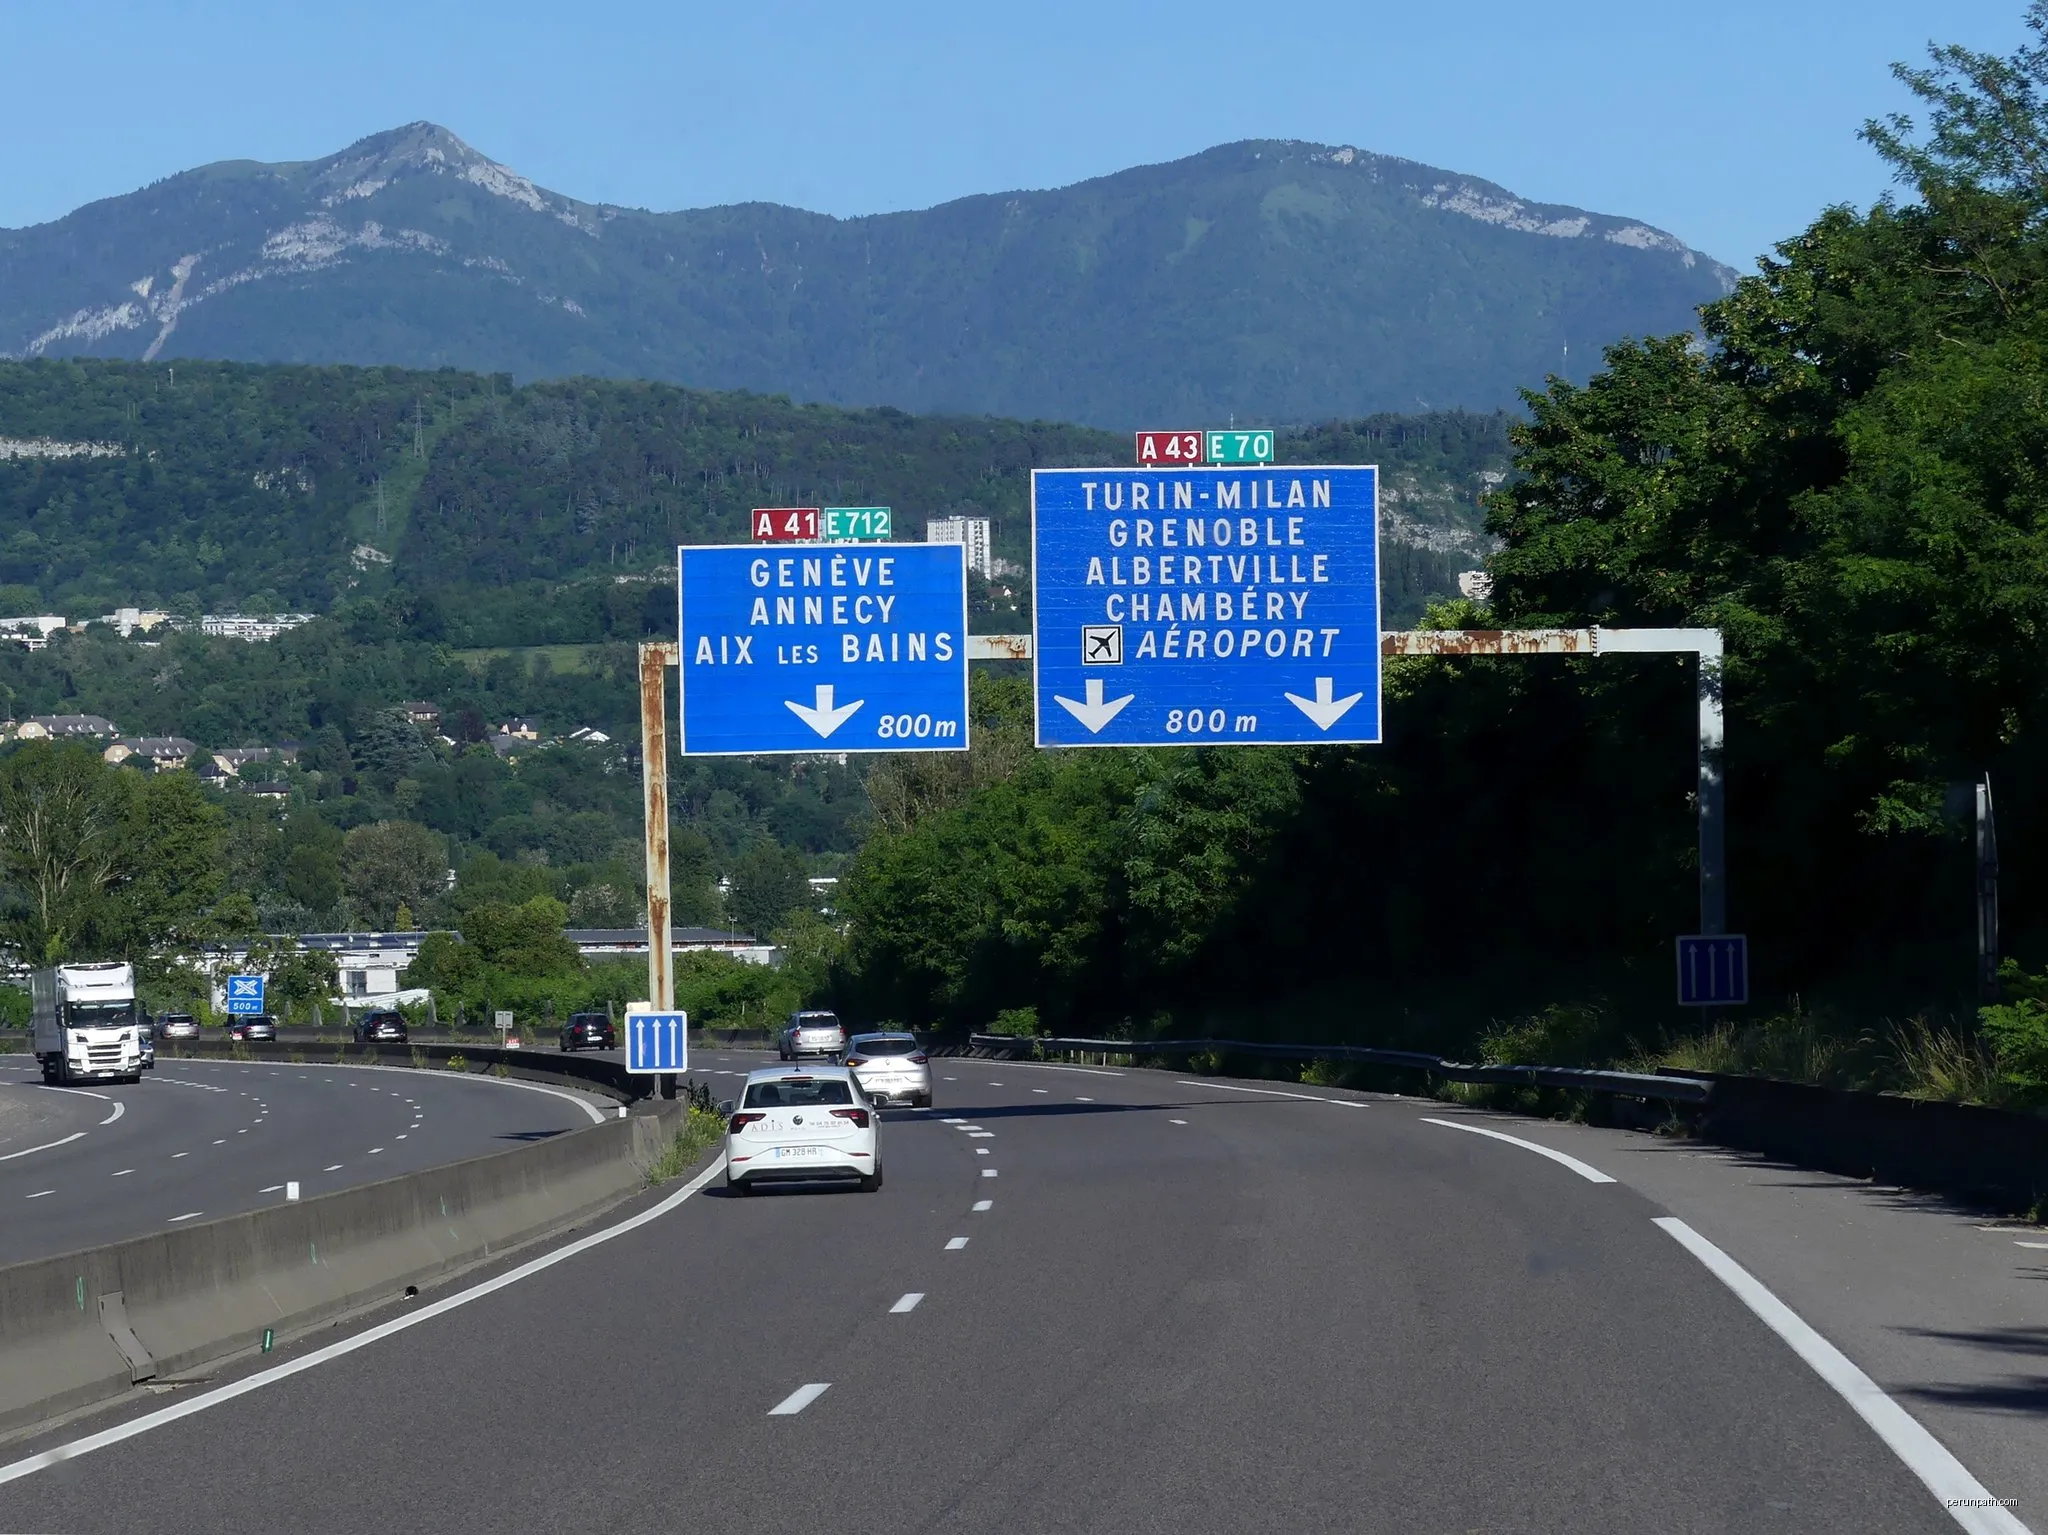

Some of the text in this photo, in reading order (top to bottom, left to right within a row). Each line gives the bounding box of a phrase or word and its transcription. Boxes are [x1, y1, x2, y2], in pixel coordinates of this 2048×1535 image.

[1142, 435, 1198, 459] A 43
[1212, 435, 1269, 458] E 70
[1082, 480, 1330, 510] TURIN-MILAN
[758, 512, 815, 536] A 41
[828, 511, 889, 534] E 712
[1109, 518, 1305, 547] GRENOBLE
[751, 554, 895, 588] GENÈVE
[1086, 555, 1329, 585] ALBERTVILLE
[751, 596, 896, 625] ANNECY
[1106, 586, 1309, 622] CHAMBÉRY
[695, 633, 953, 664] AIX LES BAINS
[1136, 623, 1340, 659] AÉROPORT
[1165, 710, 1257, 733] 800 m
